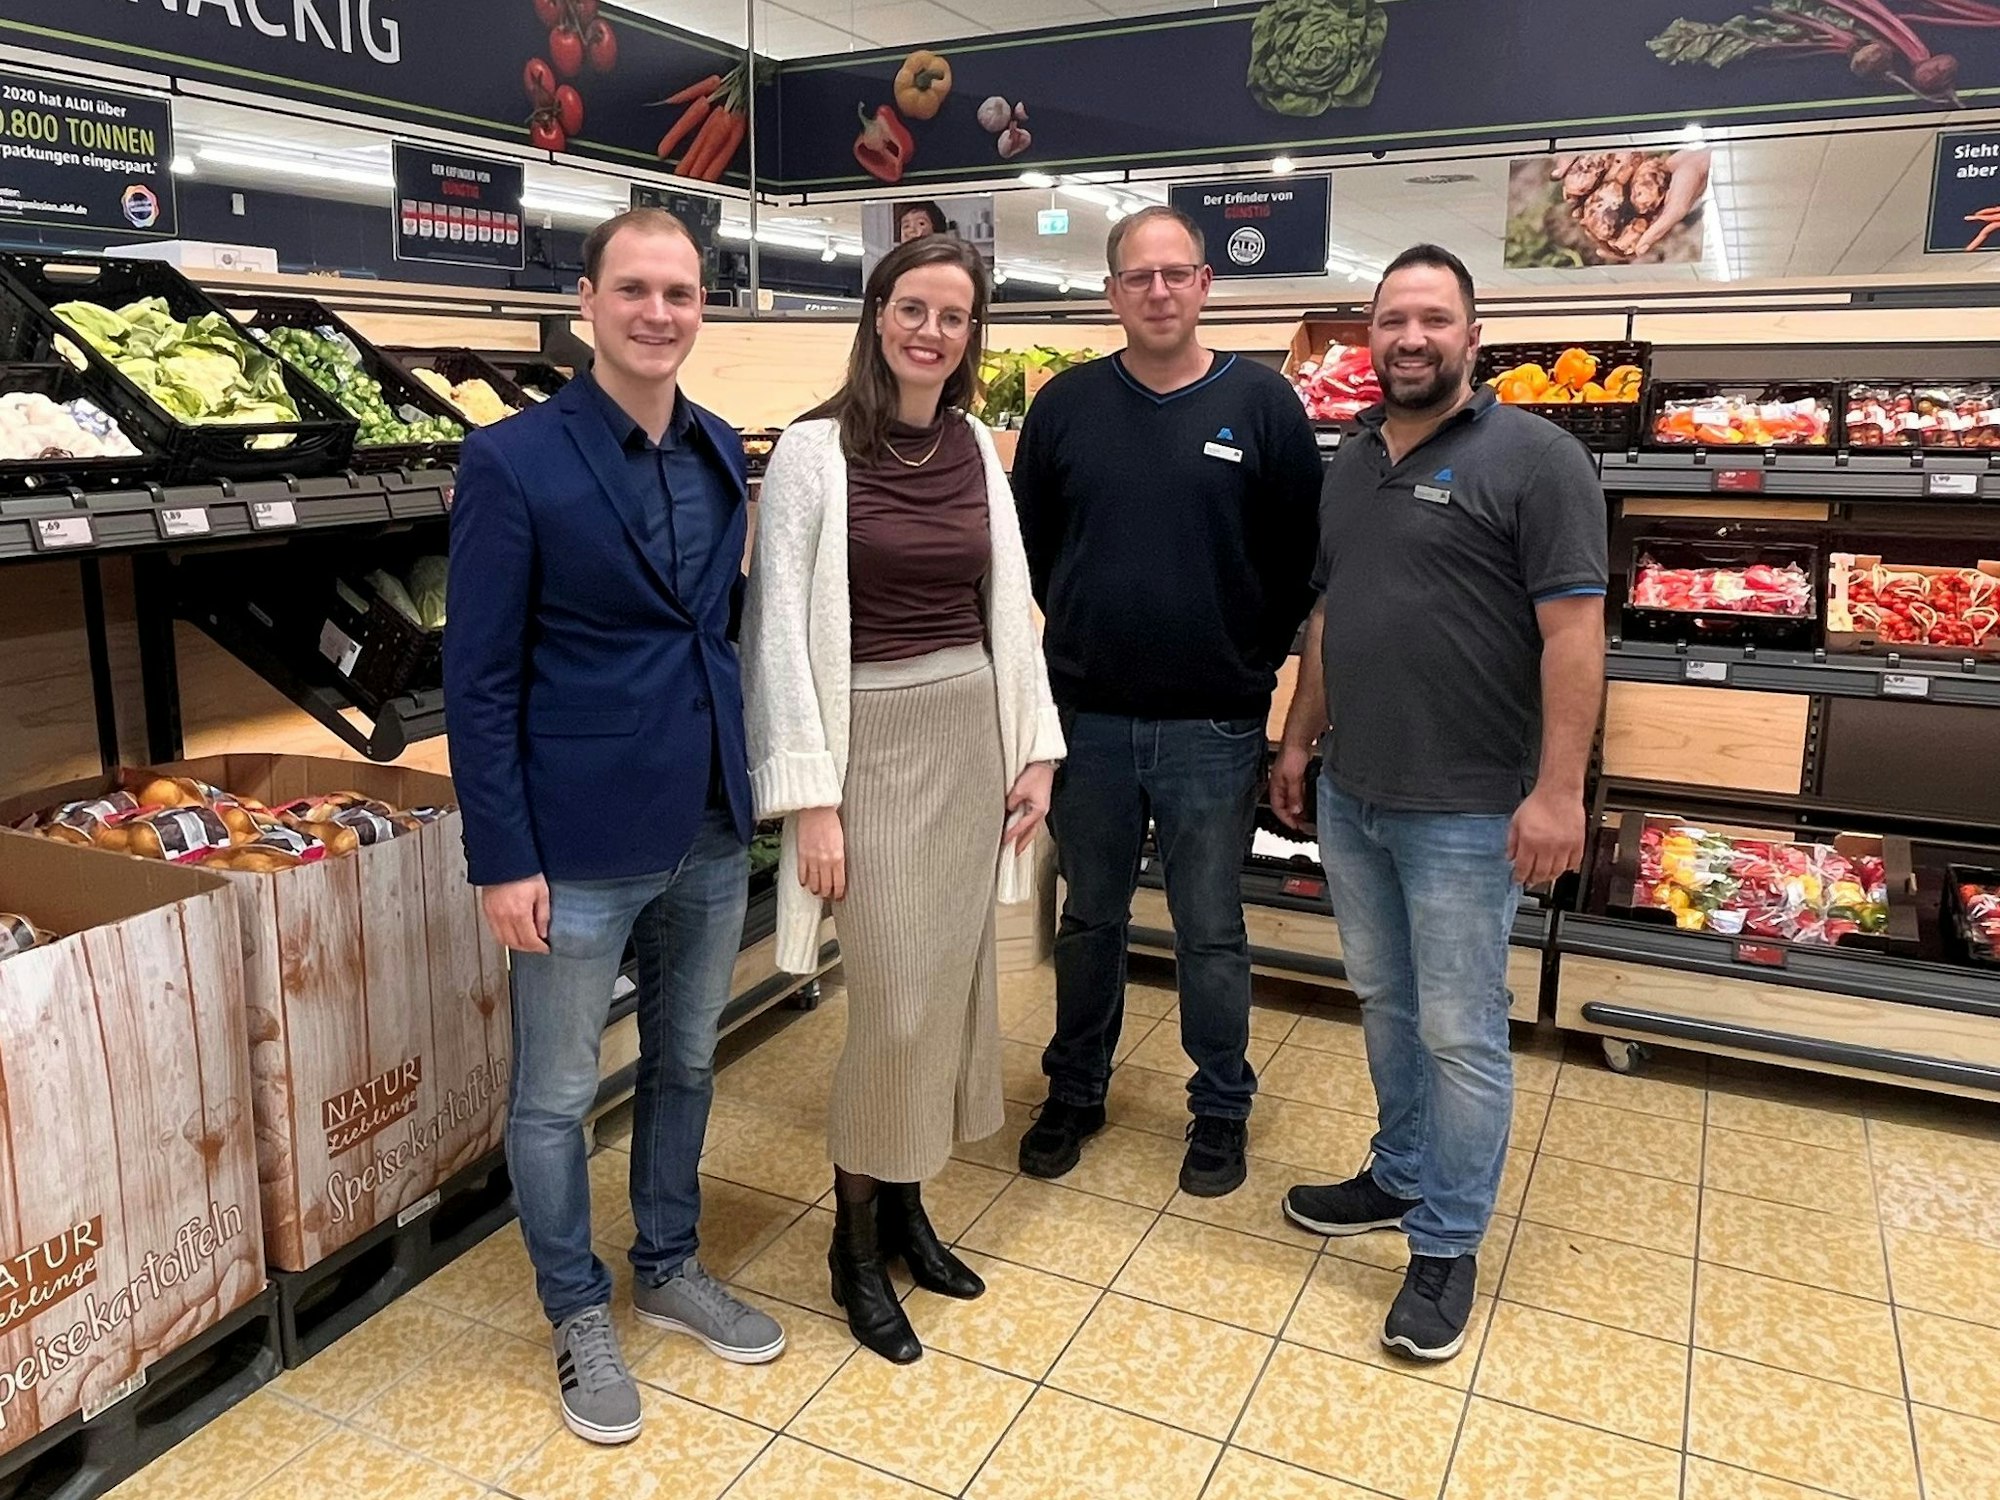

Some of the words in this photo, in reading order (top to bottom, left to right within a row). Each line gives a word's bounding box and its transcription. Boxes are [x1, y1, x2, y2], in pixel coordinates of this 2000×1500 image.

[3, 85, 36, 104] 2020
[39, 91, 62, 107] hat
[65, 96, 94, 113] ALDI
[97, 100, 127, 118] über
[65, 117, 156, 156] TONNEN
[1954, 144, 1999, 159] Sieht
[0, 144, 80, 166] packungen
[1956, 164, 1998, 178] aber
[1203, 195, 1223, 206] Der
[1225, 191, 1269, 204] Erfinder
[1271, 191, 1293, 201] von
[327, 1059, 420, 1127] NATUR
[328, 1090, 418, 1153] Lieblinge
[326, 1054, 510, 1224] Speisekartoffeln
